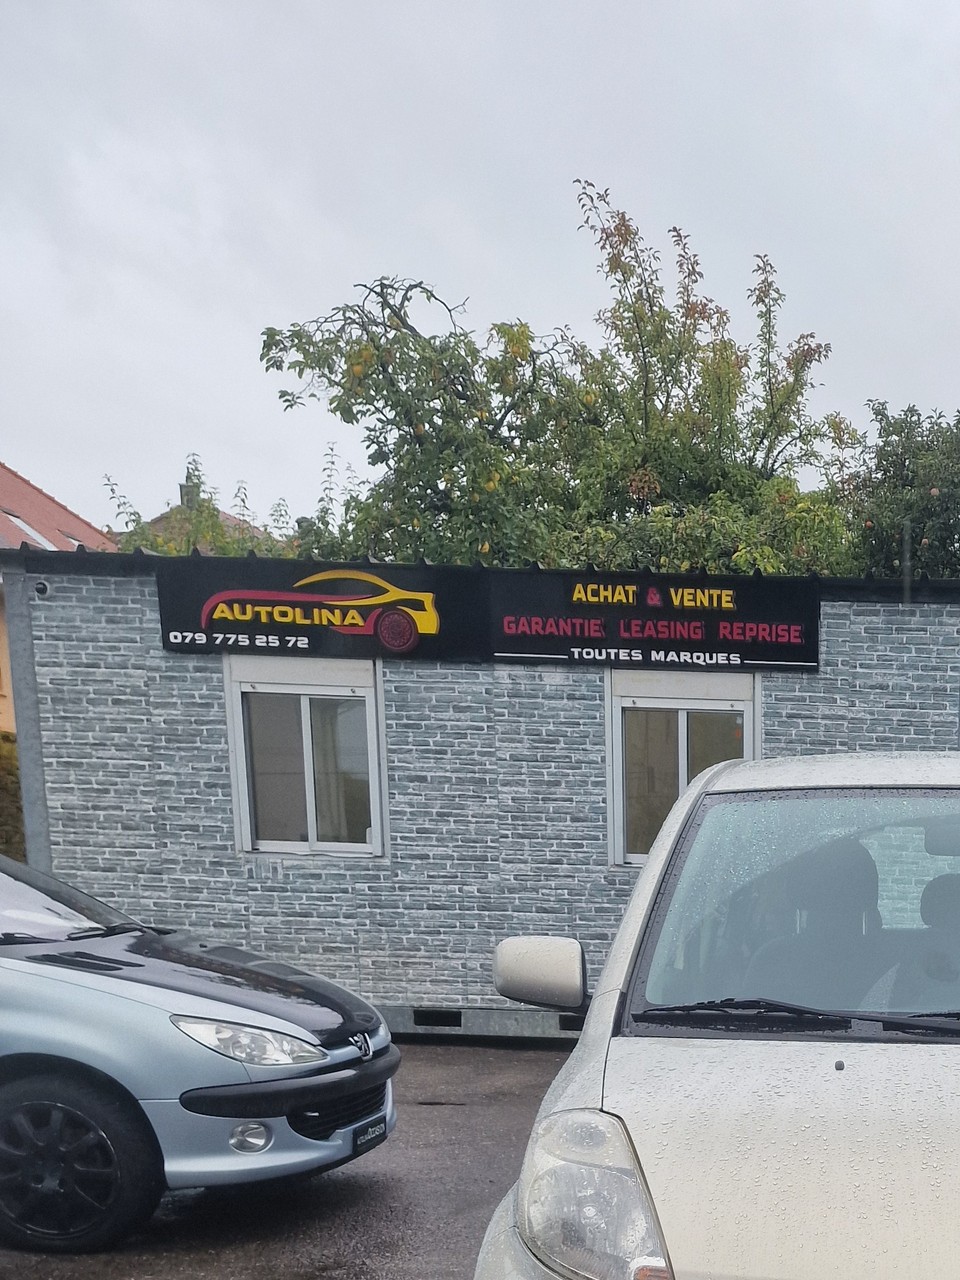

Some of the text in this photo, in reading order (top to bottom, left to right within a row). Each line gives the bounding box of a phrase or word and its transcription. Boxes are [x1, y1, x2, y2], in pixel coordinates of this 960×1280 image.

[572, 583, 735, 608] ACHAT & VENTE
[212, 602, 365, 627] AUTOLINA
[168, 631, 310, 649] 079 775 25 72
[503, 615, 803, 643] GARANTIE LEASING REPRISE
[570, 647, 741, 665] TOUTES MARQUES
